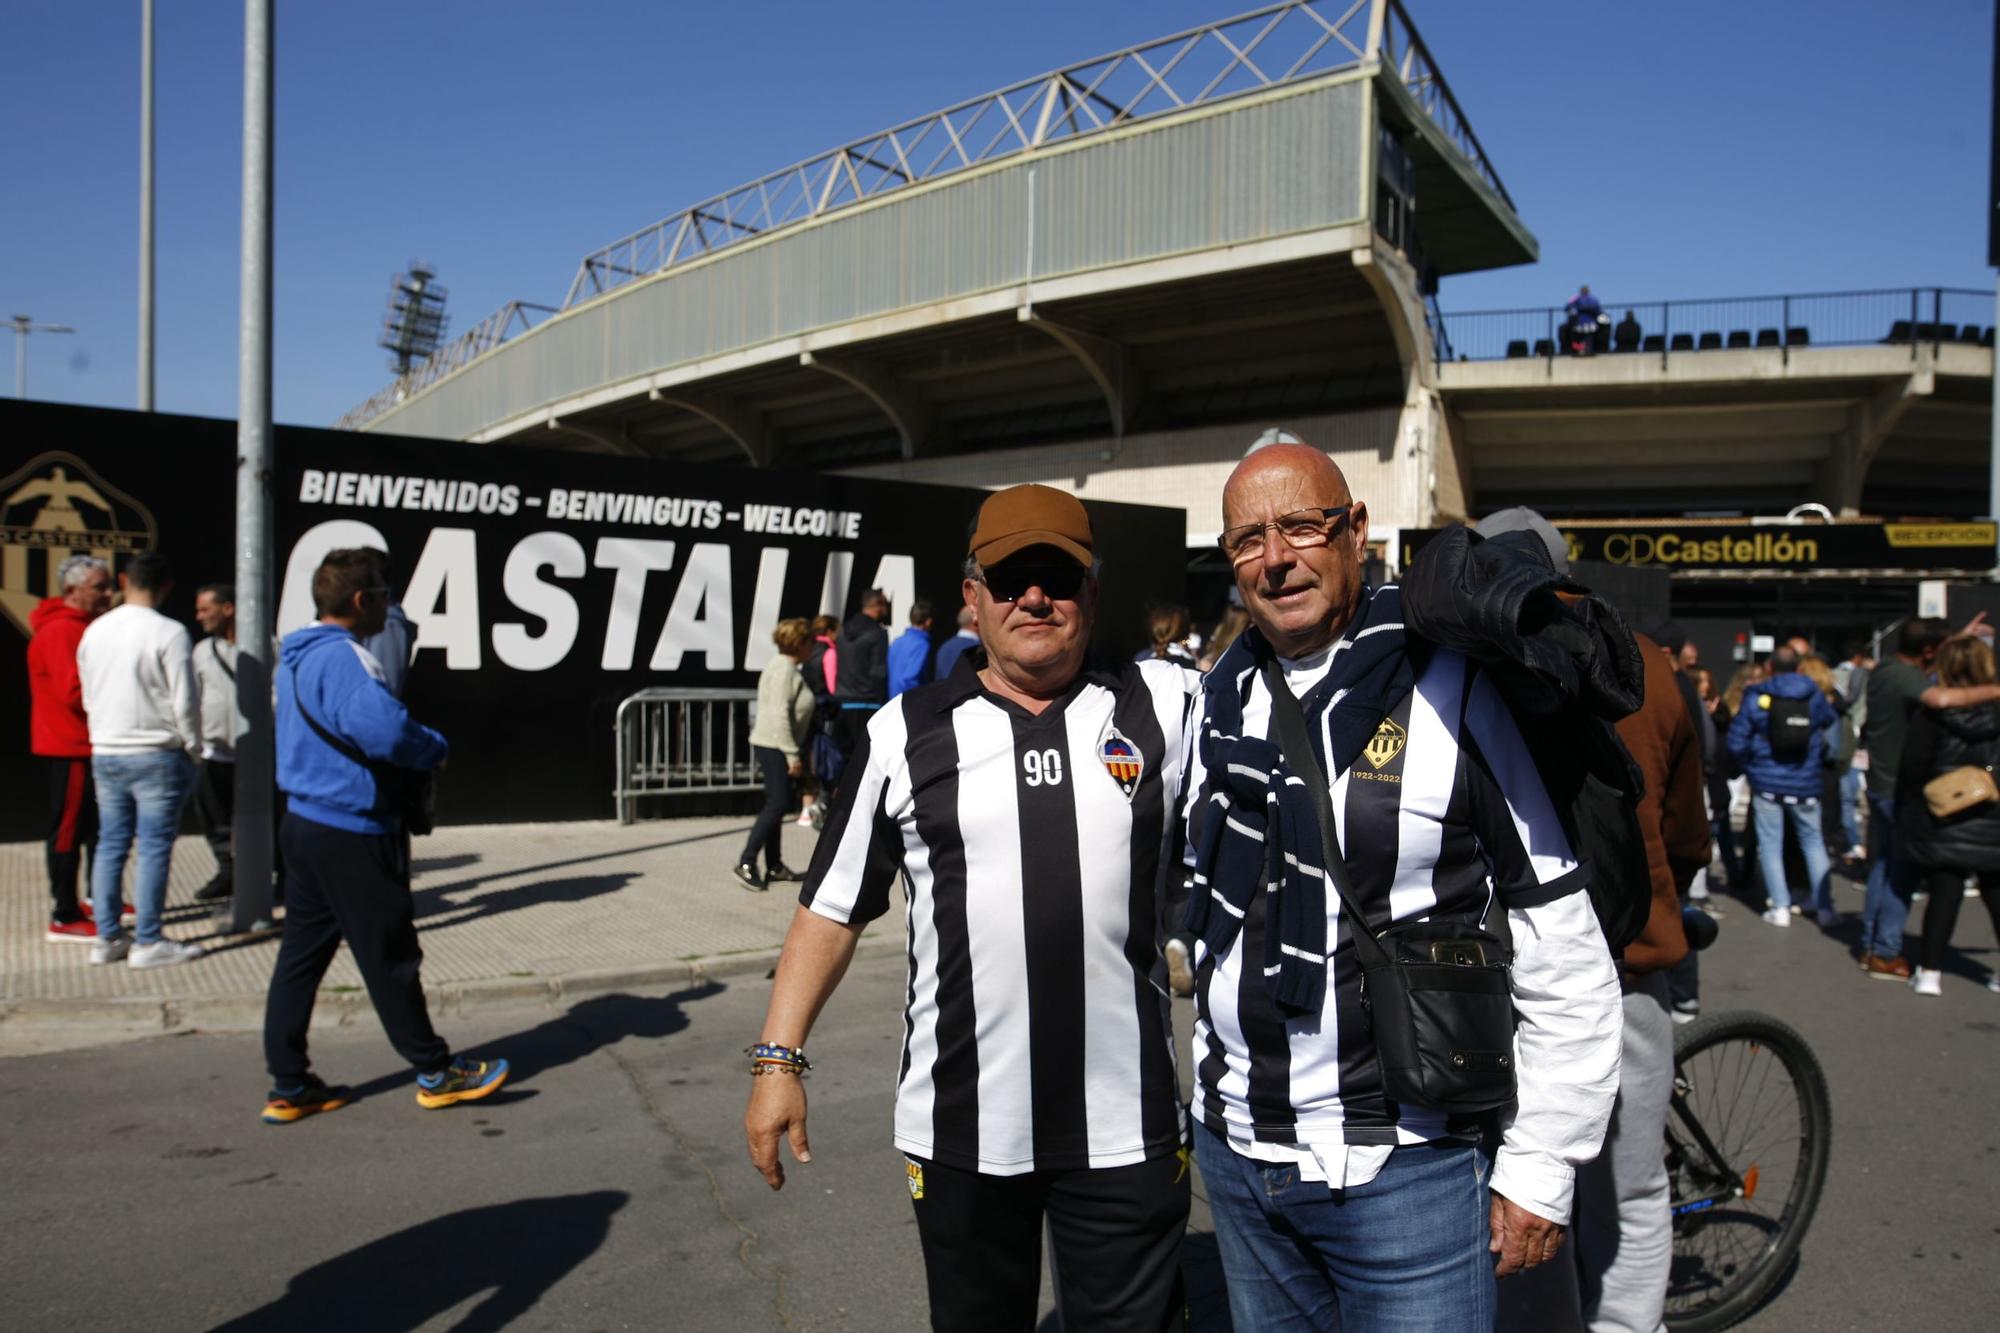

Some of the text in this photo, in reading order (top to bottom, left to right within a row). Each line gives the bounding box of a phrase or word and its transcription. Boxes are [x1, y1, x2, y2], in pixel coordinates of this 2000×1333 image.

[299, 469, 520, 515] BIENVENIDOS
[546, 489, 722, 529] BENVINGUTS
[743, 504, 862, 539] WELCOME
[1023, 748, 1062, 787] 90
[1351, 771, 1401, 783] 1922-2022
